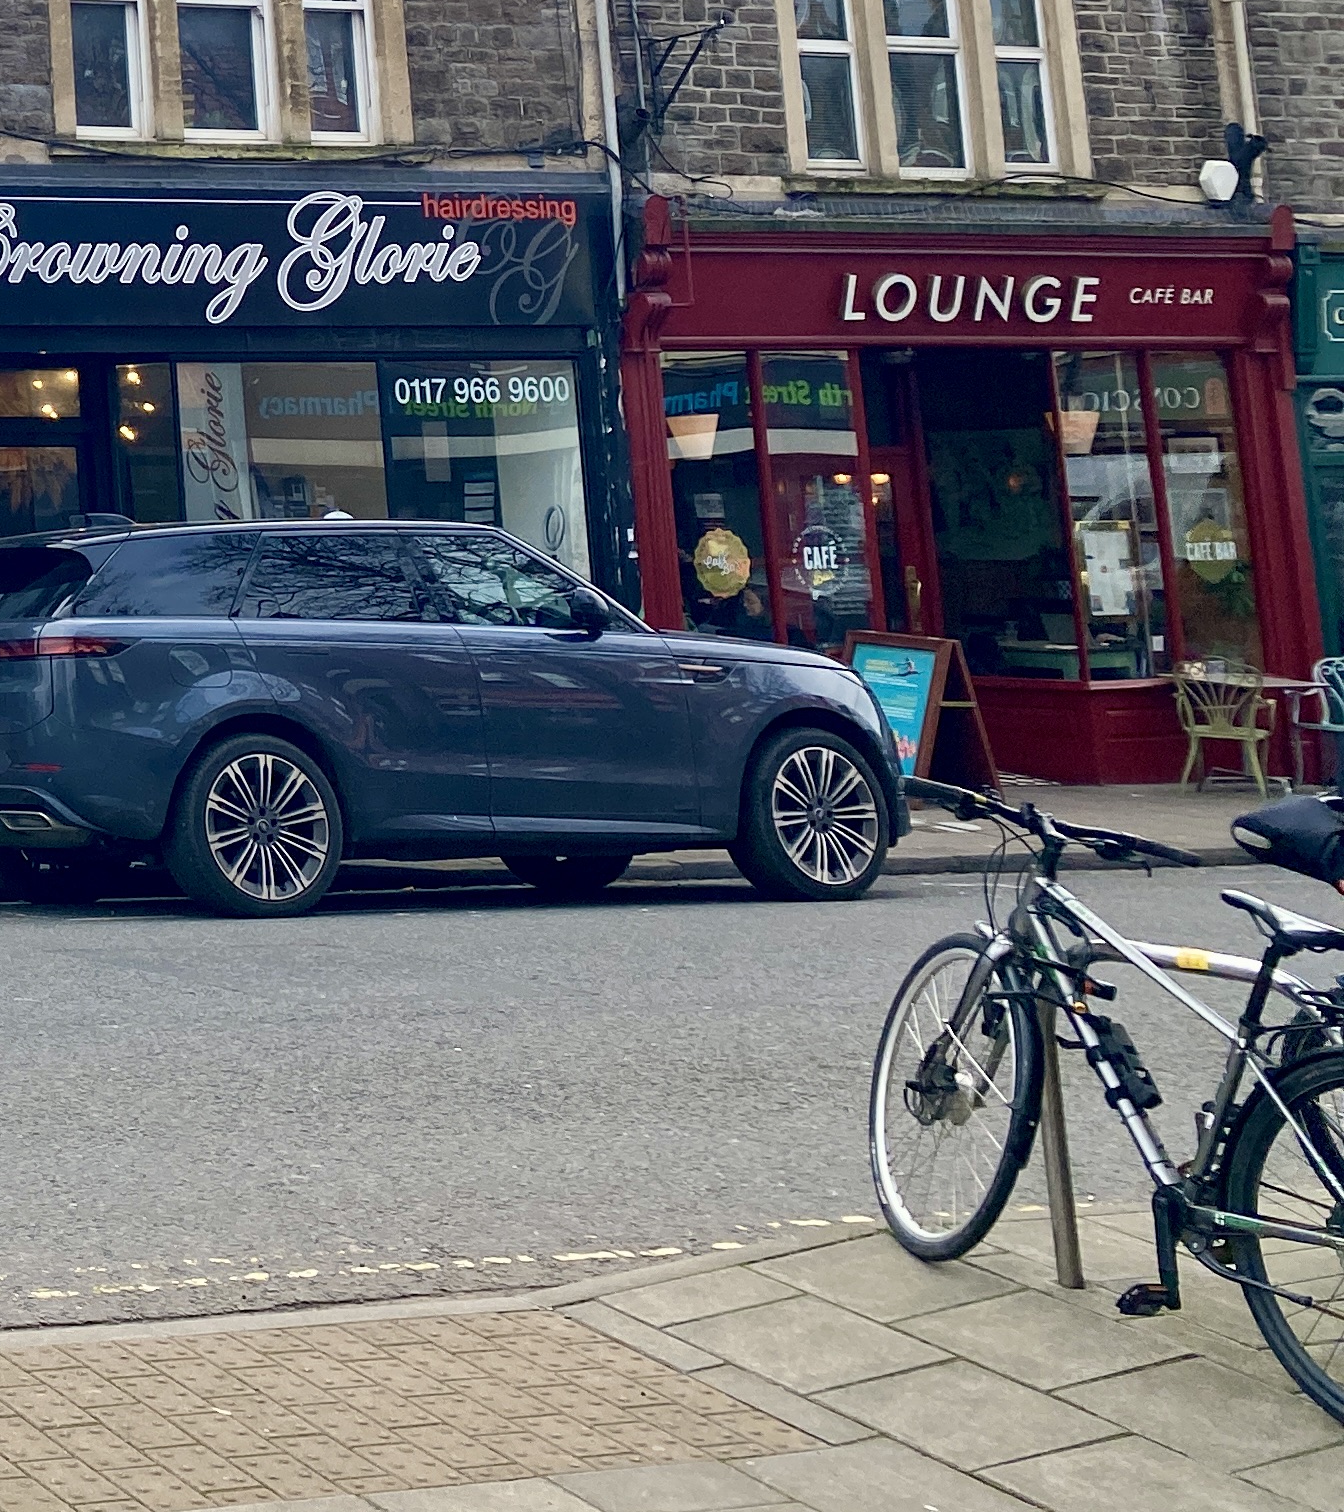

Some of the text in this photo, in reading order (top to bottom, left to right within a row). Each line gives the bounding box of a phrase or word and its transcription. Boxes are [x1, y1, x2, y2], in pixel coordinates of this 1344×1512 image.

[422, 192, 578, 226] hairdressing
[277, 190, 481, 312] Glorie
[841, 273, 1214, 324] LOUNGE CAFÉ BAR
[395, 376, 570, 405] 0117 966 9600
